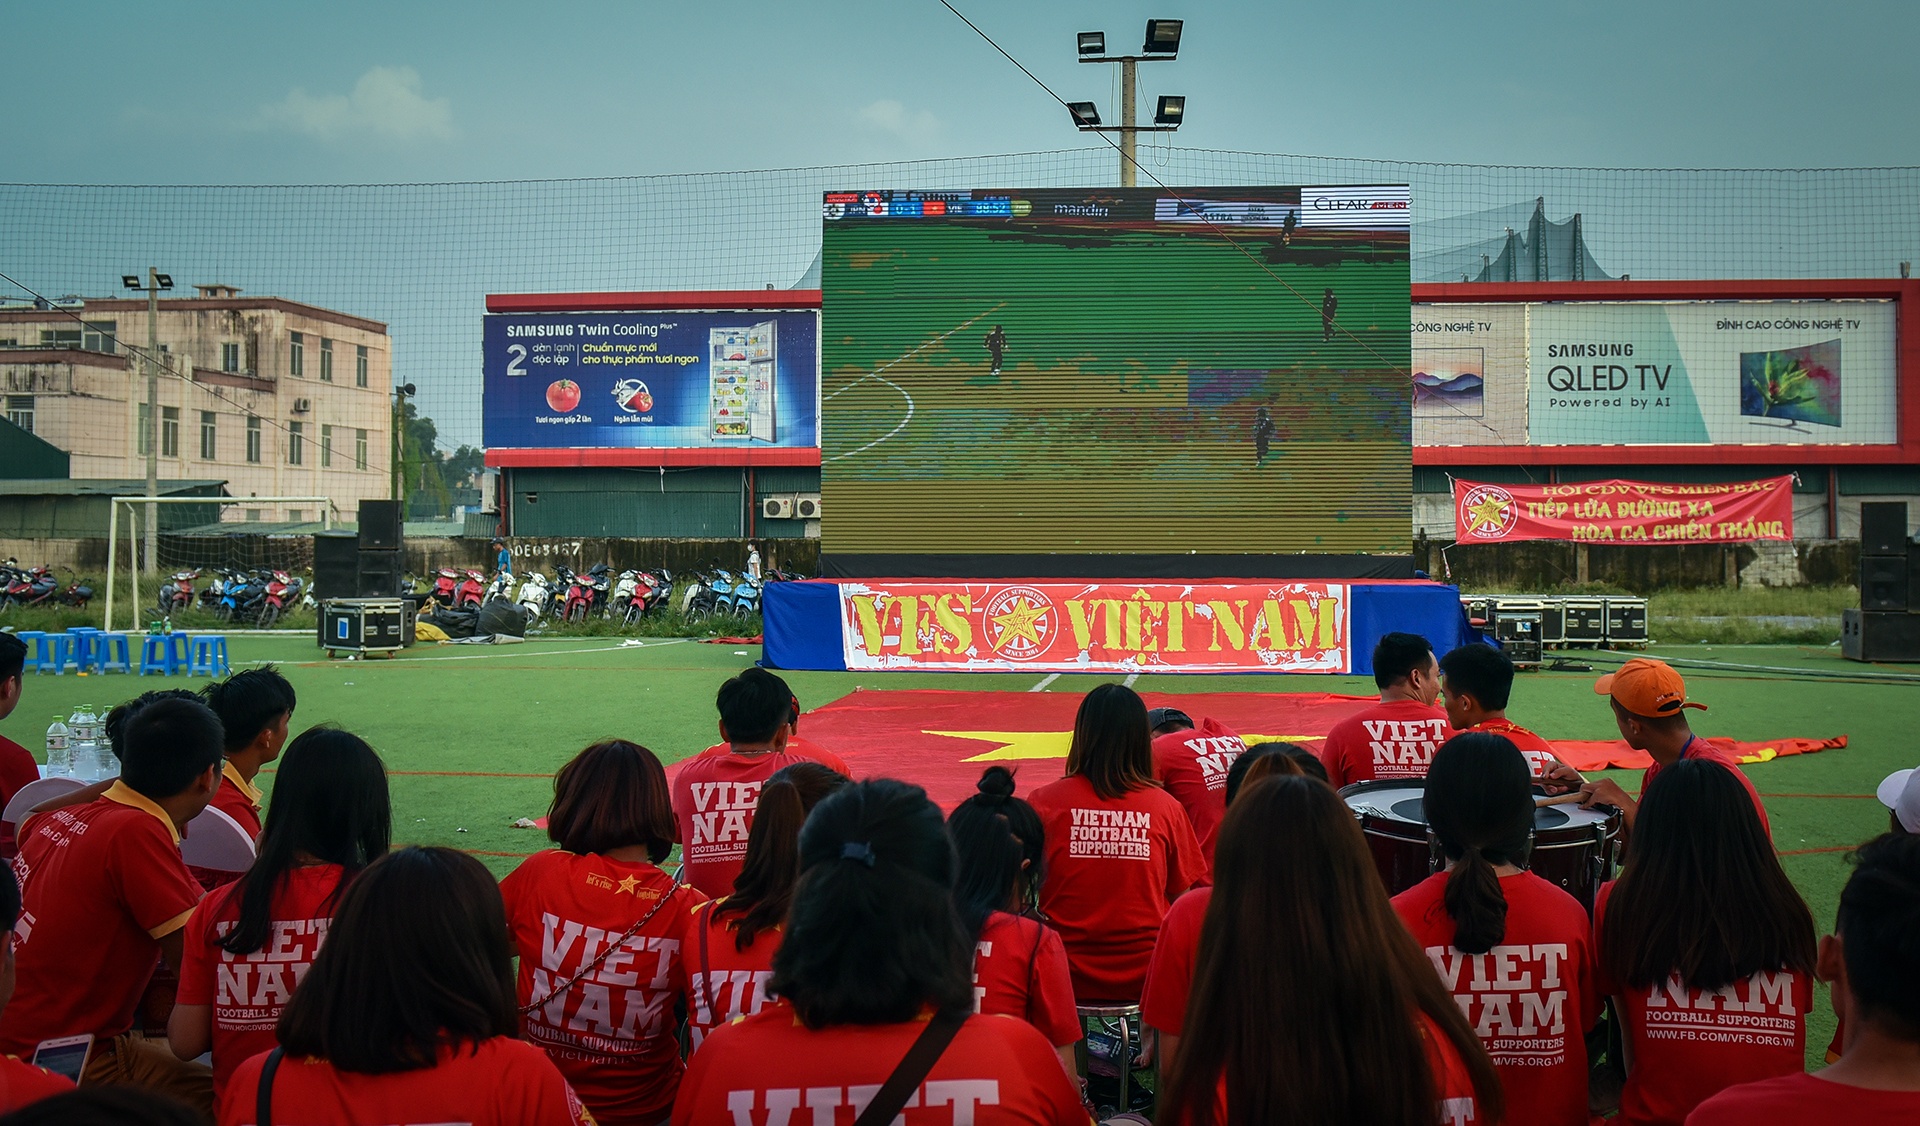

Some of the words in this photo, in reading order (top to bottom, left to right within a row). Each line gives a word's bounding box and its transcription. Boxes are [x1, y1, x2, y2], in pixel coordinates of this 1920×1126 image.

[1314, 197, 1368, 210] CLEAR
[506, 324, 574, 336] SAMSUNG
[578, 324, 610, 336] Twin
[612, 323, 658, 337] Cooling
[1444, 320, 1475, 334] NGHỆ
[1478, 322, 1492, 332] TV
[1746, 320, 1772, 330] CAO
[1774, 318, 1810, 330] CÔNG
[1812, 317, 1843, 332] NGHỆ
[1846, 320, 1861, 330] TV
[532, 343, 552, 352] dàn
[554, 343, 575, 354] lạnh
[582, 342, 614, 352] Chuẩn
[616, 344, 638, 355] mực
[638, 342, 658, 352] mới
[1548, 344, 1634, 358] SAMSUNG
[506, 344, 528, 376] 2
[532, 354, 552, 366] độc
[554, 354, 570, 366] lập
[582, 355, 600, 364] cho
[602, 355, 624, 366] thực
[624, 353, 653, 366] phẩm
[655, 354, 673, 364] tươi
[674, 356, 699, 366] ngon
[1547, 364, 1629, 392] QLED
[1634, 364, 1672, 391] TV
[1550, 398, 1622, 408] Powered
[1630, 397, 1648, 410] by
[1655, 398, 1670, 407] AI
[1542, 485, 1582, 497] HỘI
[1585, 485, 1630, 495] CĐV
[1526, 497, 1568, 519] TIẾP
[1686, 500, 1715, 518] XA
[1620, 525, 1653, 541] CA
[1653, 518, 1712, 540] CHIẾN
[988, 592, 1010, 616] FOOTBALL
[1010, 589, 1047, 605] SUPPORTERS
[1064, 588, 1195, 665] VIỆT
[1207, 597, 1338, 652] NAM
[1004, 648, 1024, 657] SINCE
[1024, 648, 1040, 656] 2014
[1362, 719, 1447, 741] VIET
[690, 779, 769, 812] VIE
[1070, 808, 1150, 829] VIETNAM
[691, 810, 756, 845] NA
[1070, 826, 1150, 844] FOOTBALL
[691, 844, 731, 854] FOOTBALL
[1069, 840, 1150, 857] SUPPORTERS
[542, 912, 680, 990] VIET
[527, 968, 671, 1040] NAM
[216, 1008, 268, 1018] FOOTBALL
[1646, 1010, 1714, 1024] FOOTBALL
[1717, 1014, 1796, 1030] SUPPORTERS
[528, 1020, 578, 1046] FOOTBALL
[1646, 1030, 1795, 1048] WWW.FB.COM/VFS.ORG.VN
[1493, 1036, 1564, 1050] SUPPORTERS
